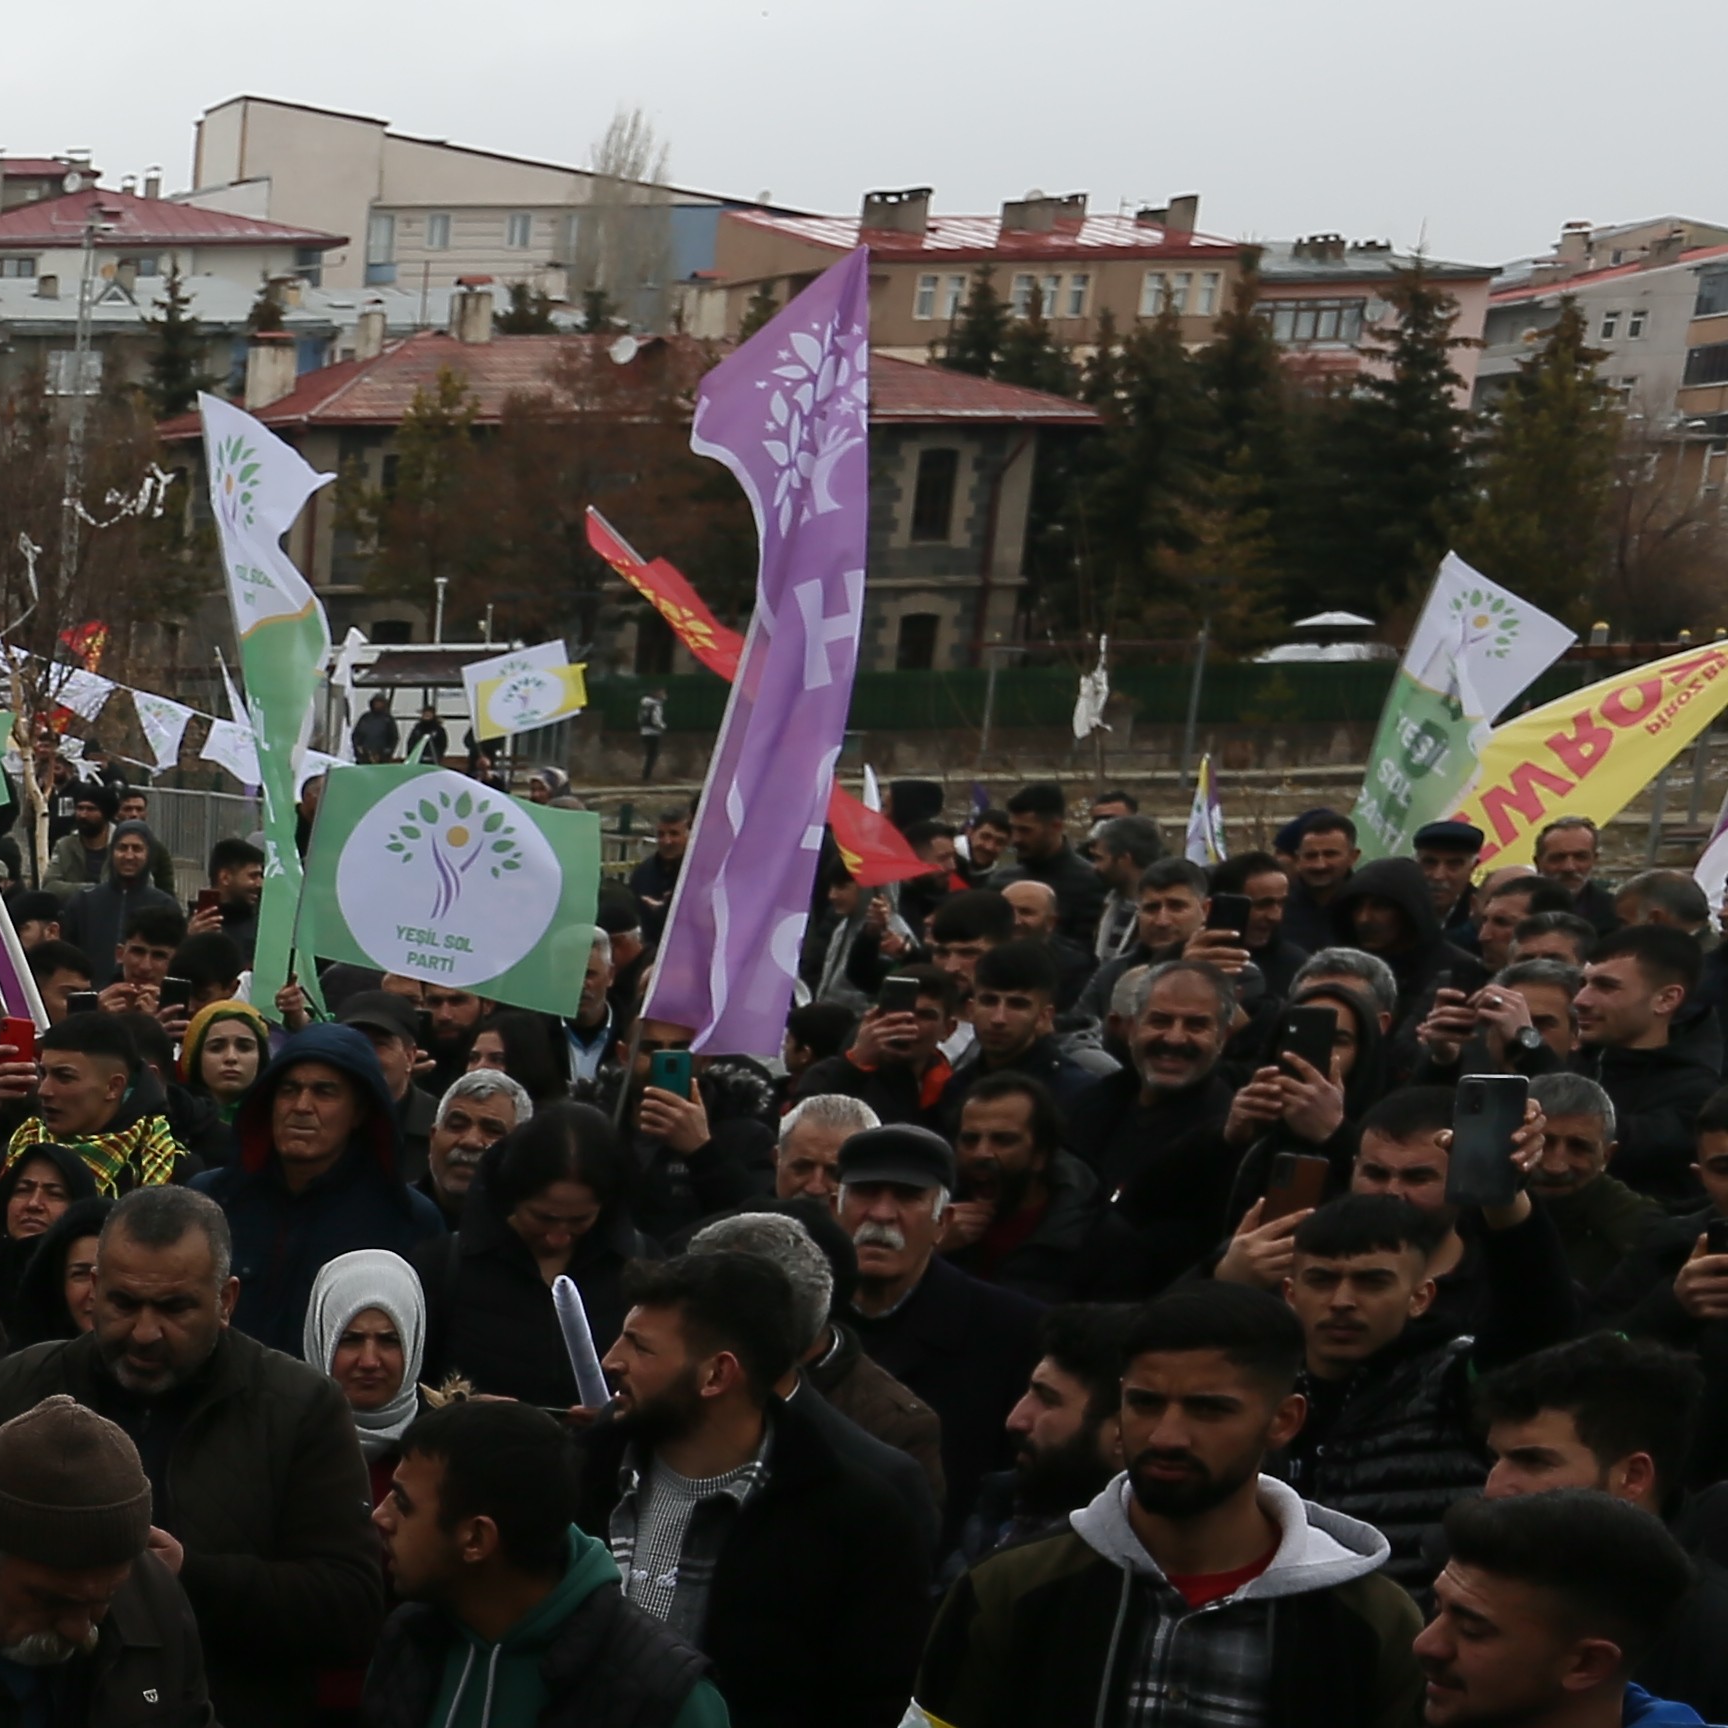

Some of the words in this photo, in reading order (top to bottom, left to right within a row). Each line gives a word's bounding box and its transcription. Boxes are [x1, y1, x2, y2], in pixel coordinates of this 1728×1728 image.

[396, 925, 441, 948] YEŞİL
[443, 933, 474, 953] SOL
[406, 951, 456, 974] PARTİ
